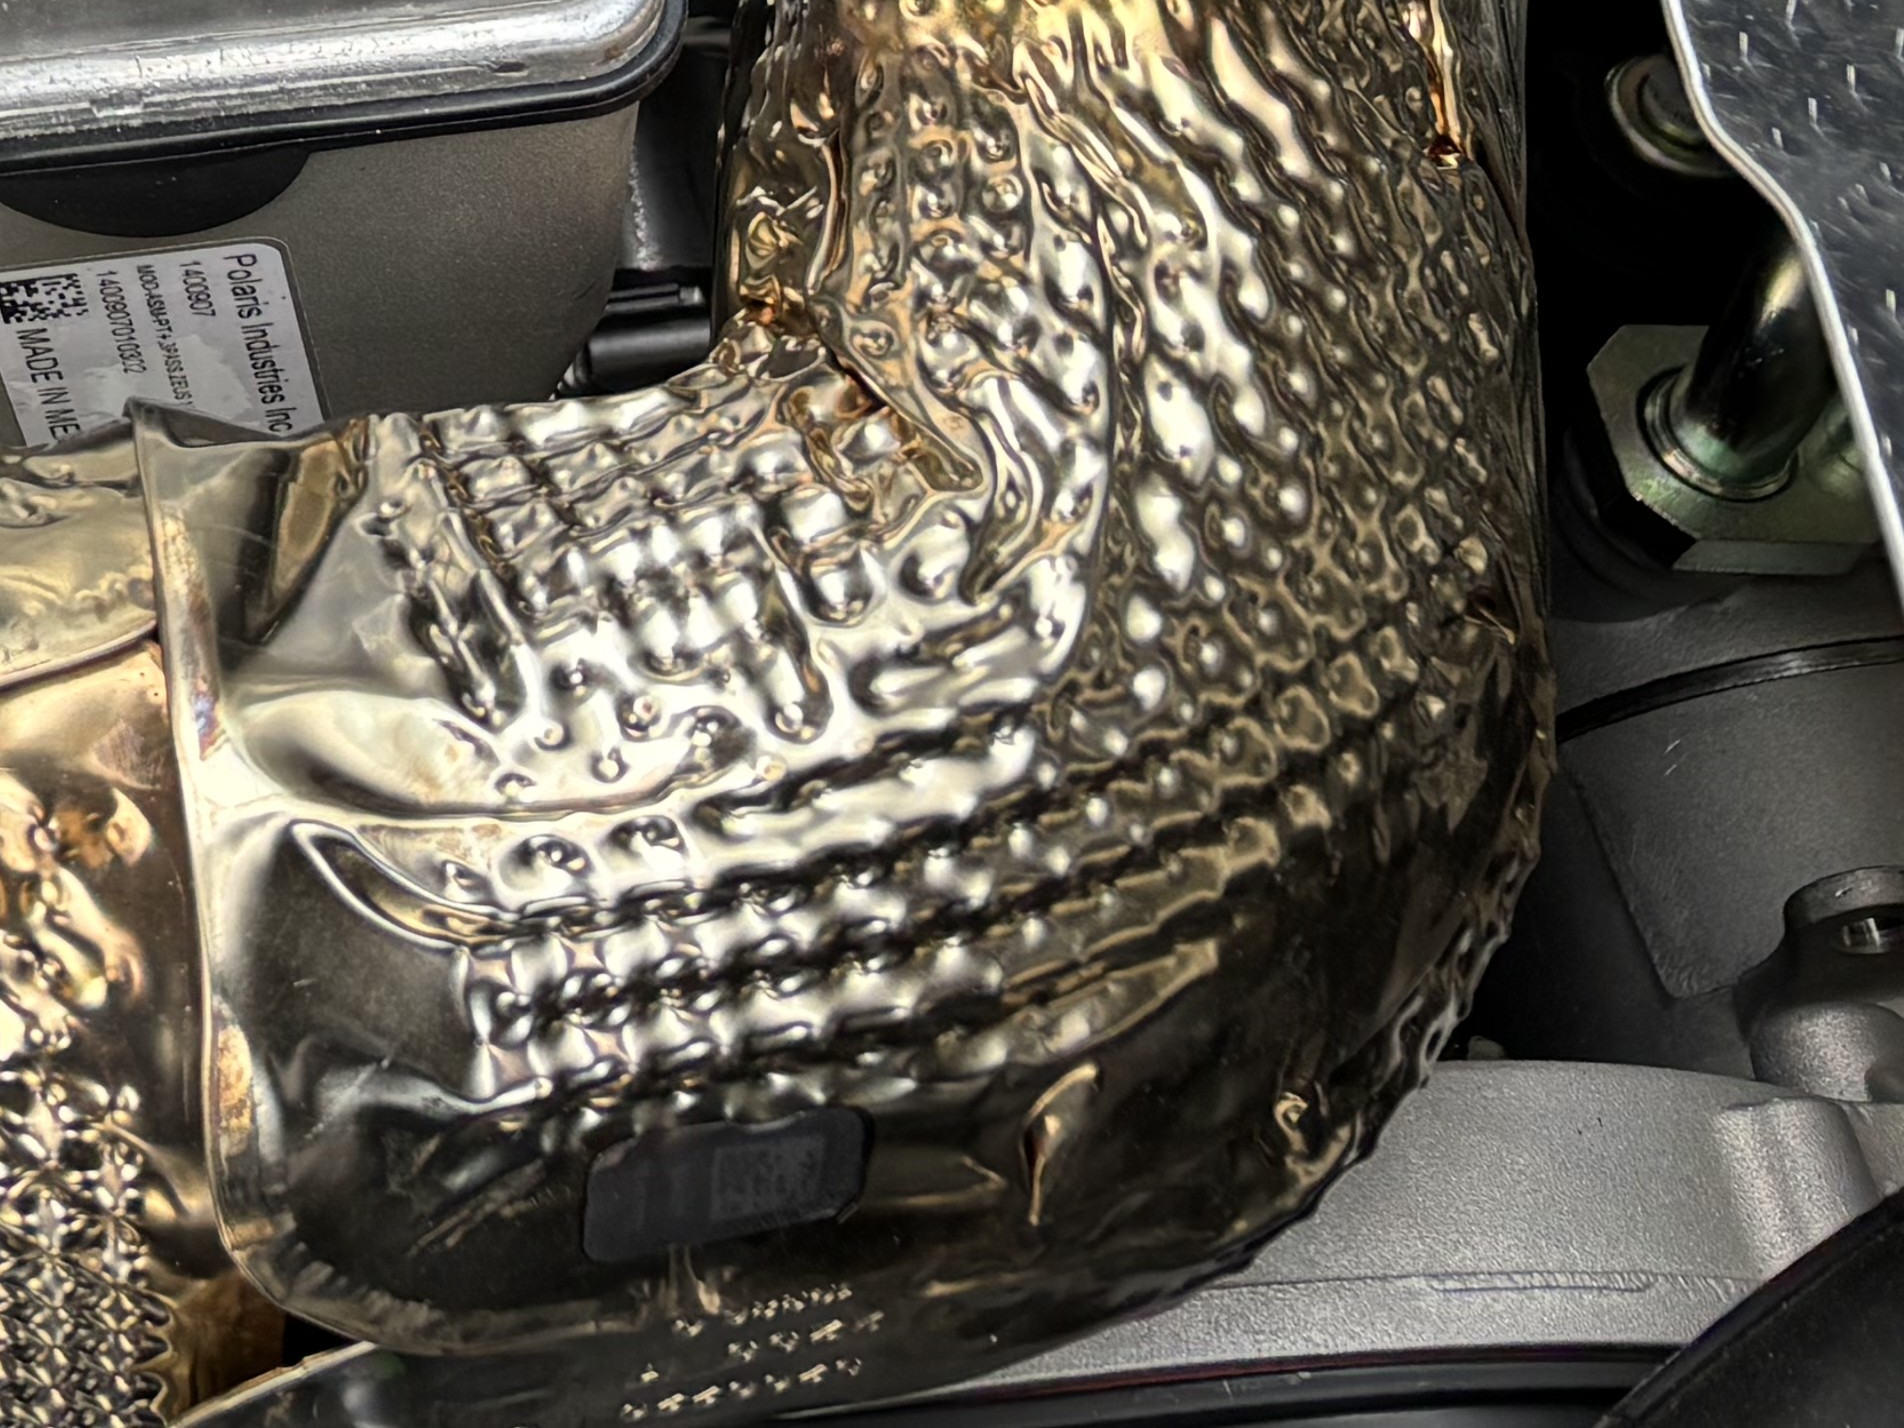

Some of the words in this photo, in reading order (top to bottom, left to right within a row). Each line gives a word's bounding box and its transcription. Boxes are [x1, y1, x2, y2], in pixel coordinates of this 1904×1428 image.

[180, 261, 216, 317] 1400907
[223, 254, 266, 319] Polaris
[15, 328, 62, 383] MADE
[240, 323, 287, 404] Industries
[39, 387, 69, 405] IN
[47, 409, 80, 439] ME
